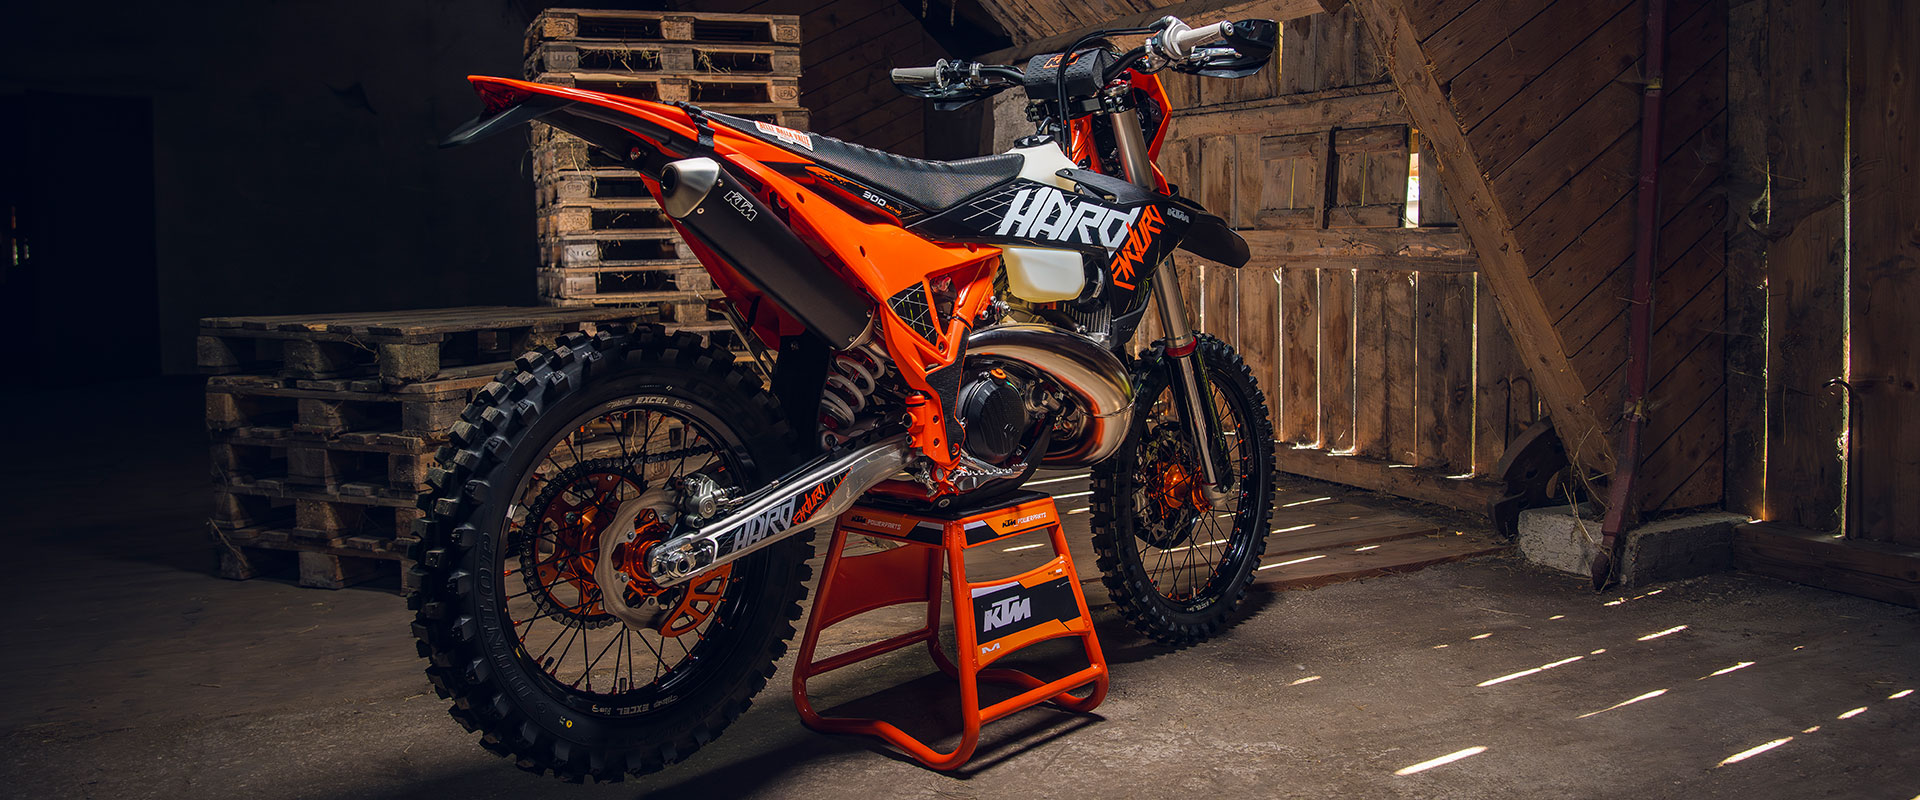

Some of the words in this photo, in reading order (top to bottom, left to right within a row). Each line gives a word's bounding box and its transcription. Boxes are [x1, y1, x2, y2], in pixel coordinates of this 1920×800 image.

[723, 190, 758, 222] KTM
[862, 190, 887, 207] 300
[1167, 206, 1190, 224] KTM
[995, 186, 1141, 258] HARD
[1110, 204, 1166, 291] ENDURO
[635, 396, 669, 405] EXCEL
[732, 495, 797, 553] HARD
[792, 482, 827, 525] ENDURO
[478, 532, 535, 700] DUNLOP
[983, 595, 1032, 632] KTM
[615, 703, 651, 716] EXCEL
